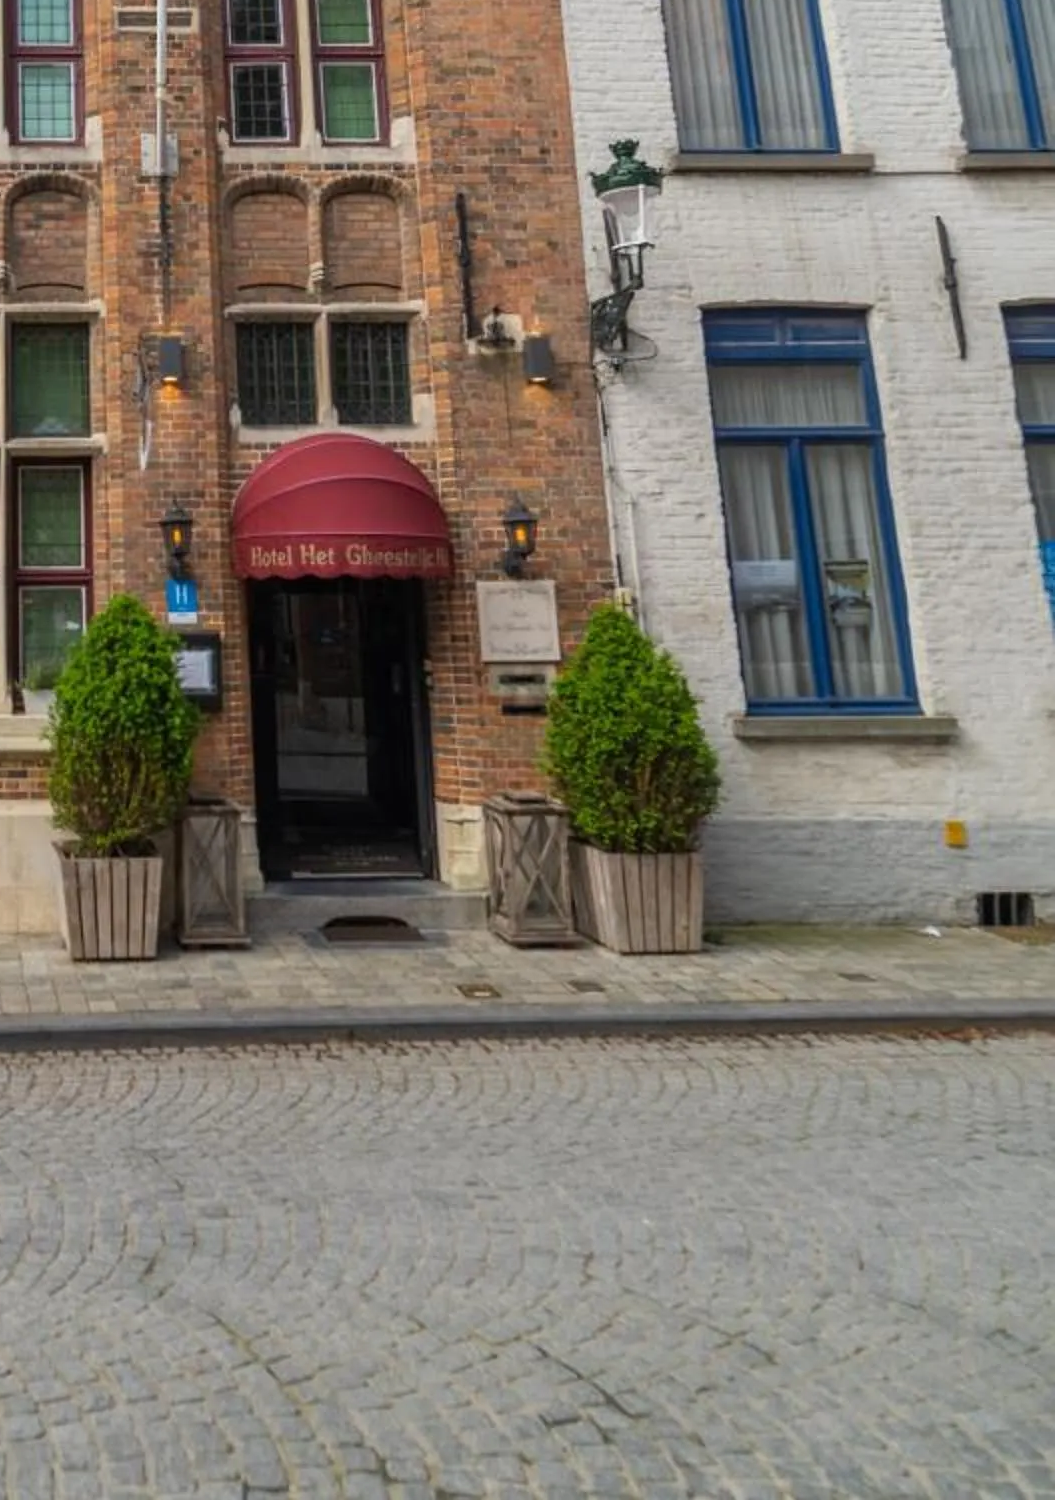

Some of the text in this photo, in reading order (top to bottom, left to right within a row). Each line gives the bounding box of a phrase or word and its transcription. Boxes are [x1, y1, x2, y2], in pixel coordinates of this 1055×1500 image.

[251, 545, 293, 568] Hotel
[299, 543, 335, 566] Het
[175, 583, 188, 605] H
